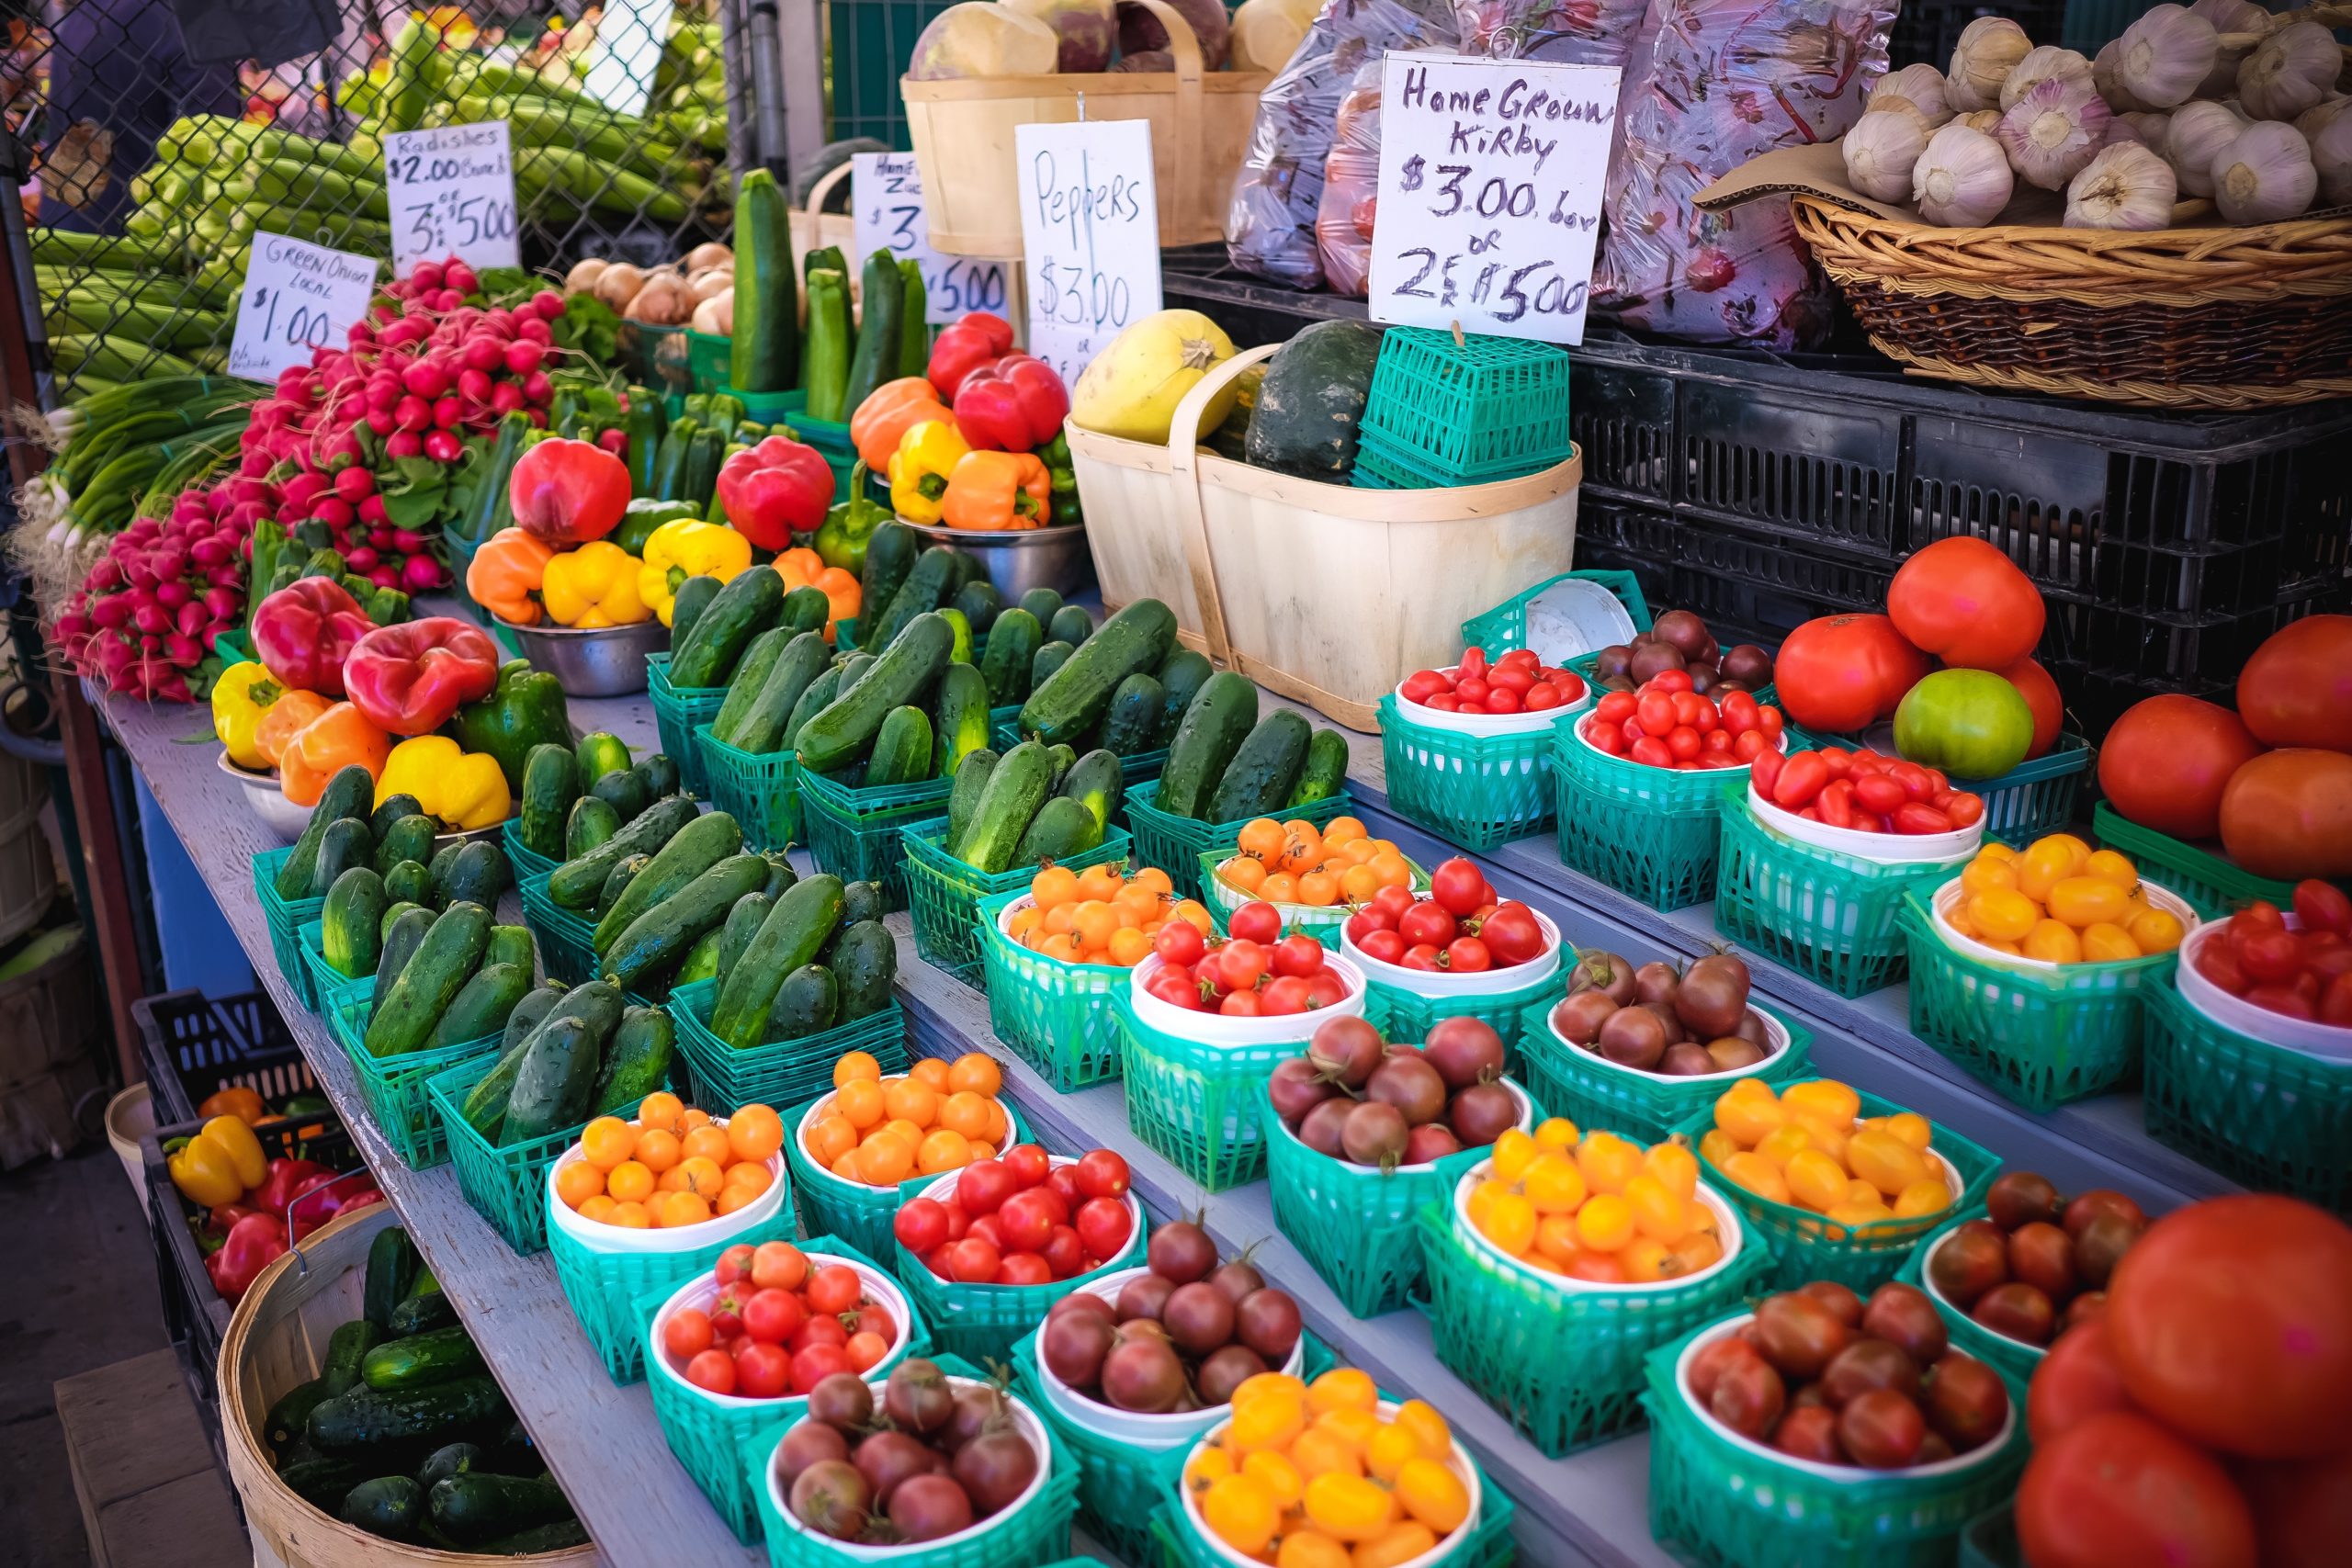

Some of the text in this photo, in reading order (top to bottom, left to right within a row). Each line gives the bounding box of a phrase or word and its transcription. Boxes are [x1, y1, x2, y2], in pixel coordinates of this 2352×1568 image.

[1402, 66, 1491, 116] Home
[396, 129, 499, 154] Radishes
[390, 155, 459, 185] $2.00
